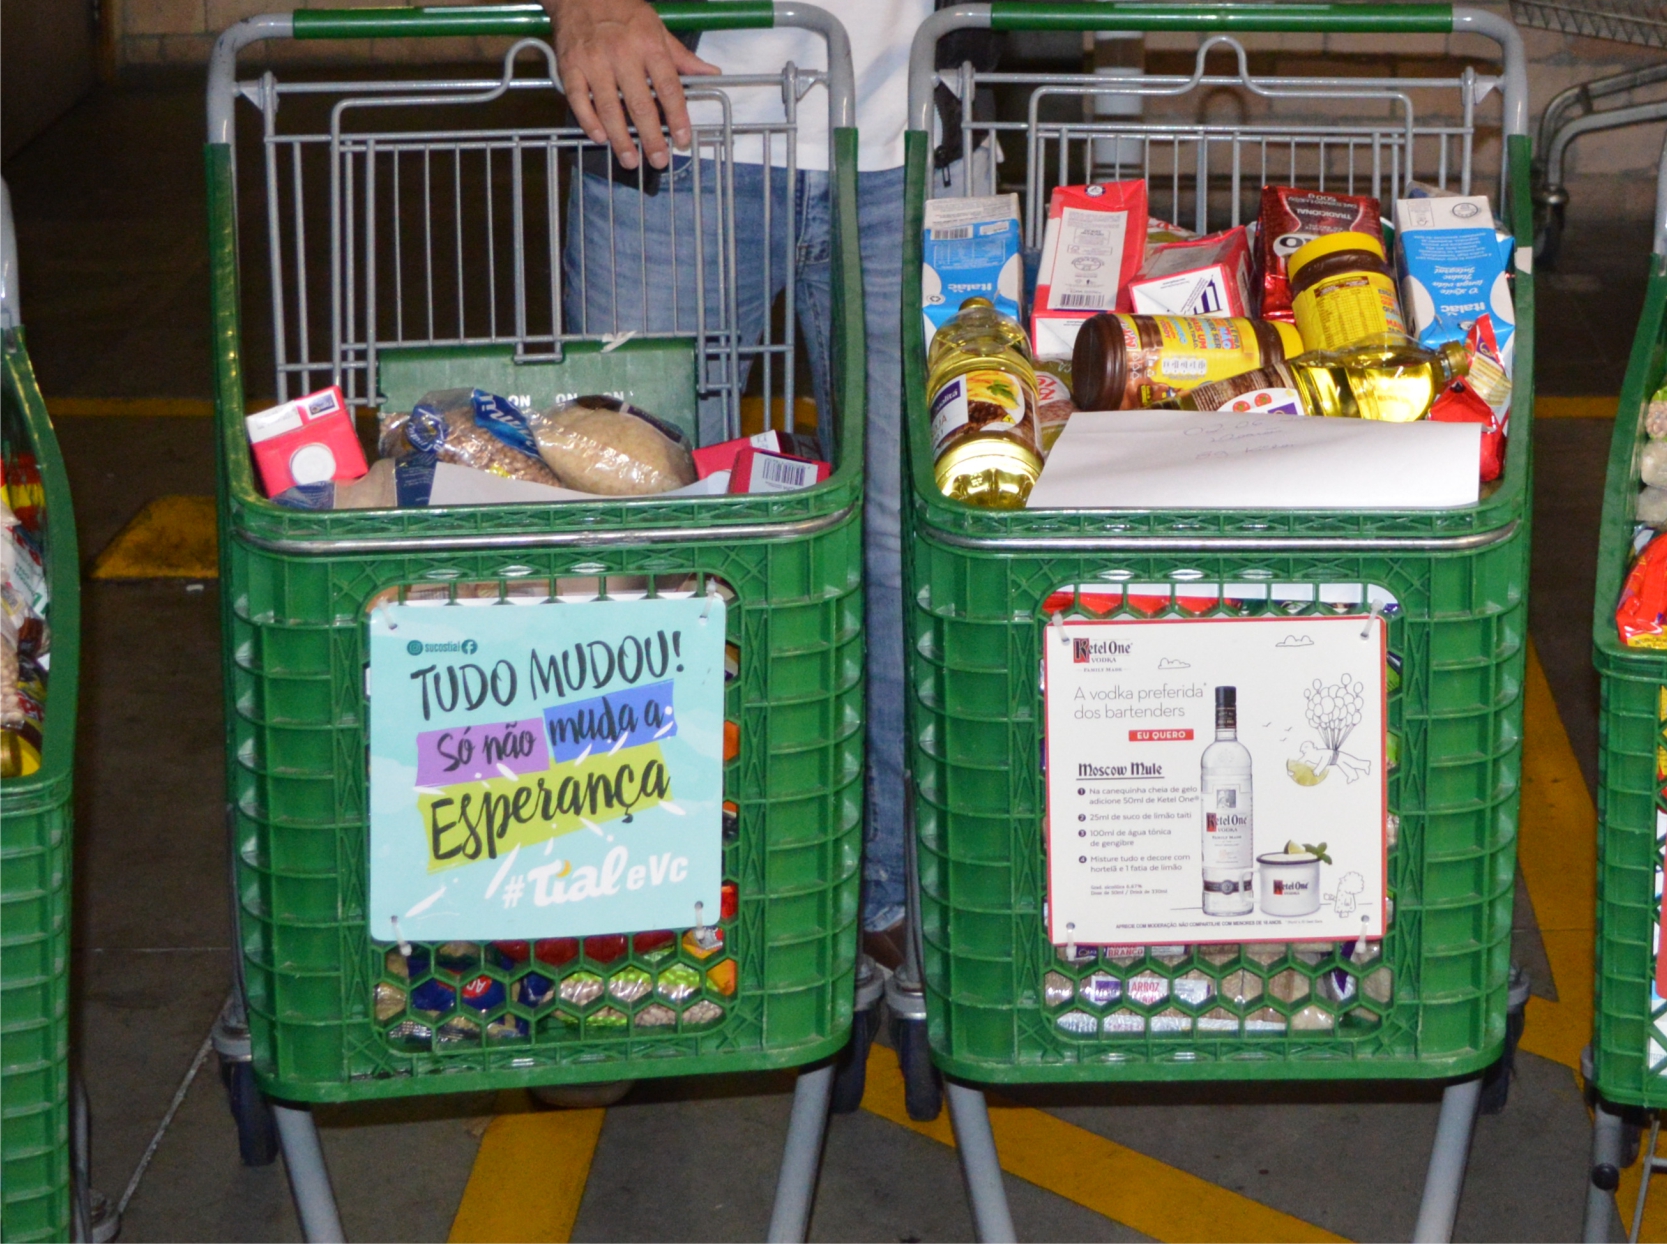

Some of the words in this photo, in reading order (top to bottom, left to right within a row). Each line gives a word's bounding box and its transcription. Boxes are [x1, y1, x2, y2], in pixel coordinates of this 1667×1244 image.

[1296, 207, 1351, 220] TRADICIONAL
[1440, 301, 1486, 316] Italac
[424, 641, 461, 653] sucostial
[1074, 639, 1107, 661] Ketel
[1108, 640, 1131, 655] One
[410, 658, 518, 721] TUDO
[529, 630, 685, 701] MUDOU!
[1074, 686, 1086, 701] A
[1089, 684, 1134, 701] vodka
[1074, 704, 1102, 720] dos
[1105, 702, 1186, 719] bartenders
[437, 726, 475, 773] Só
[482, 722, 537, 765] não
[549, 695, 638, 747] muda
[643, 698, 664, 729] a
[1137, 731, 1150, 740] EU
[1152, 730, 1187, 741] QUERO
[1078, 762, 1128, 777] Moscow
[1130, 761, 1163, 776] Mule
[1089, 787, 1100, 795] Na
[1102, 787, 1147, 798] canequinha
[1148, 786, 1168, 794] cheia
[1170, 786, 1180, 794] de
[1181, 786, 1198, 795] gelo
[1089, 797, 1121, 805] adicione
[1123, 796, 1144, 805] 50ml
[1145, 796, 1155, 804] de
[1157, 796, 1177, 804] Ketel
[429, 759, 671, 860] Esperança
[1090, 813, 1109, 821] 25ml
[1111, 813, 1121, 821] de
[1153, 812, 1175, 820] limão
[1090, 829, 1114, 837] 100ml
[1116, 829, 1126, 837] de
[1128, 829, 1147, 838] água
[1148, 828, 1172, 836] tônica
[1101, 839, 1134, 848] gengibre
[1090, 855, 1119, 863] Misture
[1090, 865, 1117, 873] hortelã
[1130, 864, 1148, 872] fatia
[1161, 863, 1183, 871] limão
[1131, 981, 1160, 993] ARROZ
